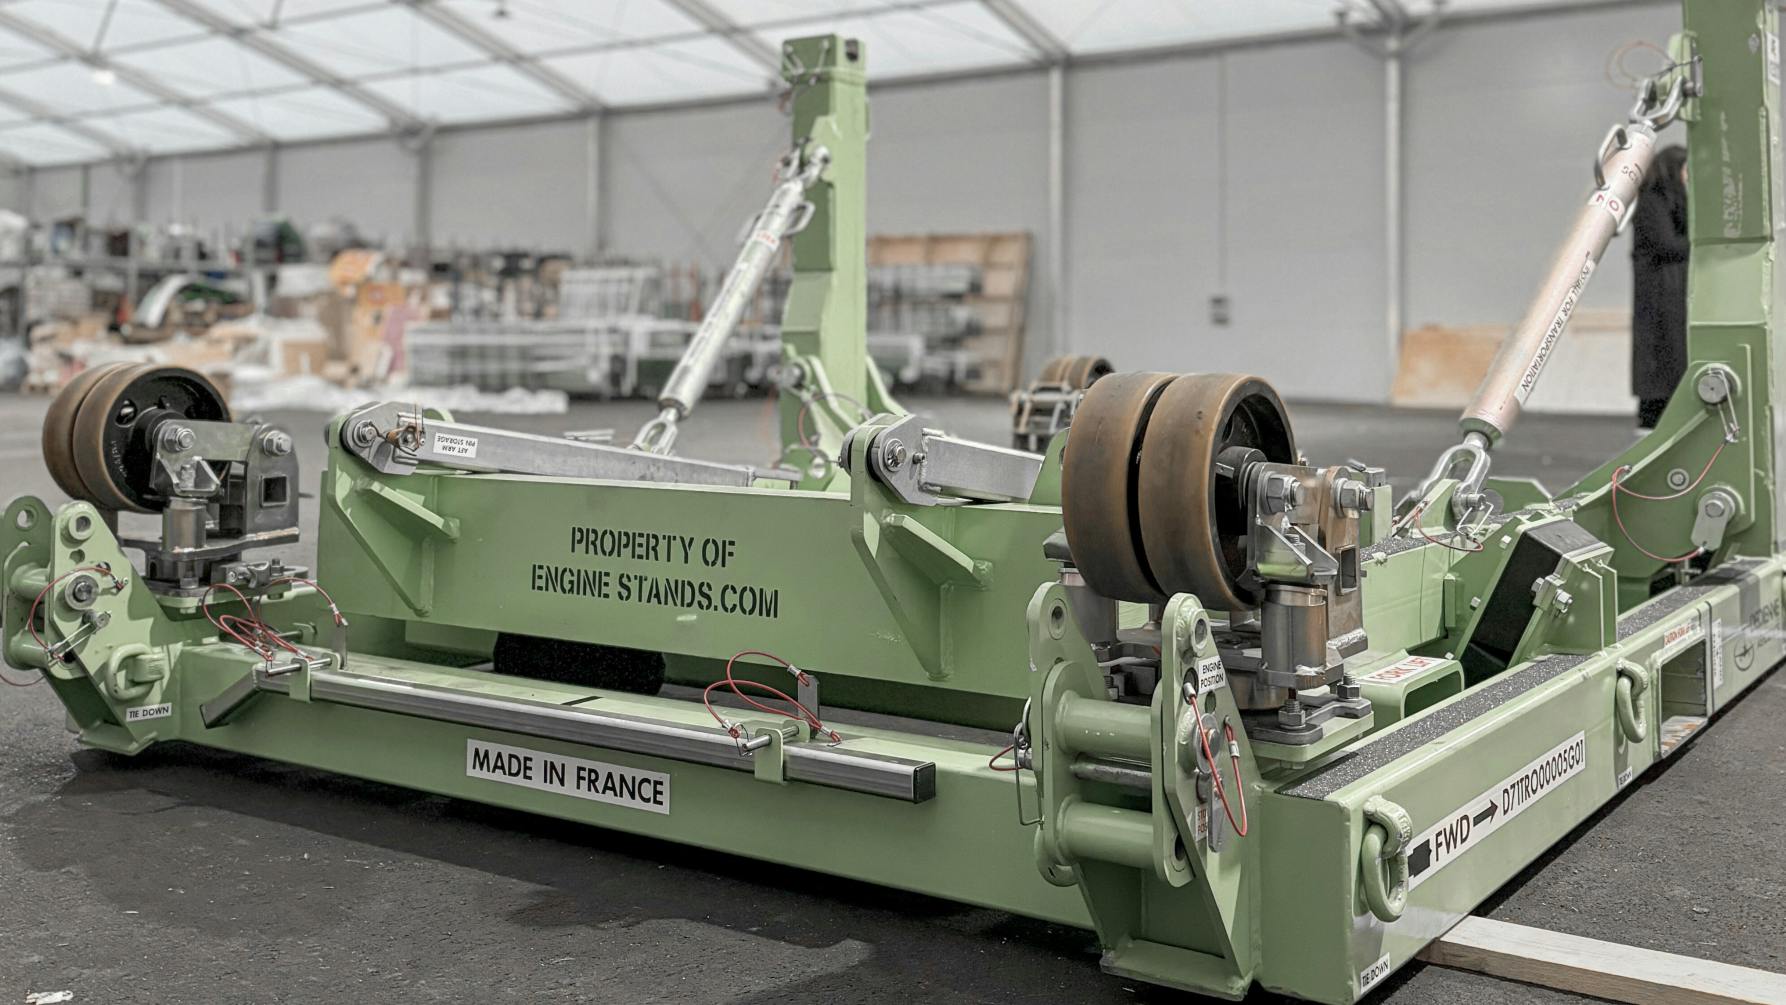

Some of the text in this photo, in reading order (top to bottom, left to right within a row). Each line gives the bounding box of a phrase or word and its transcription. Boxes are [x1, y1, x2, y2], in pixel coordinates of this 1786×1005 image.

[1562, 297, 1573, 317] FOR
[1521, 317, 1564, 392] TRANSPORTATION
[437, 435, 464, 446] STORAGE
[570, 526, 736, 568] PROPERTY OF
[531, 564, 779, 619] ENGINE STANDS.COM
[1202, 660, 1221, 674] ENGINE
[1200, 673, 1223, 688] POSITION
[129, 706, 169, 718] TIE DOWN
[472, 747, 664, 805] MADE IN FRANCE
[1435, 814, 1470, 862] FWD
[1362, 961, 1389, 987] TIE DOWN
